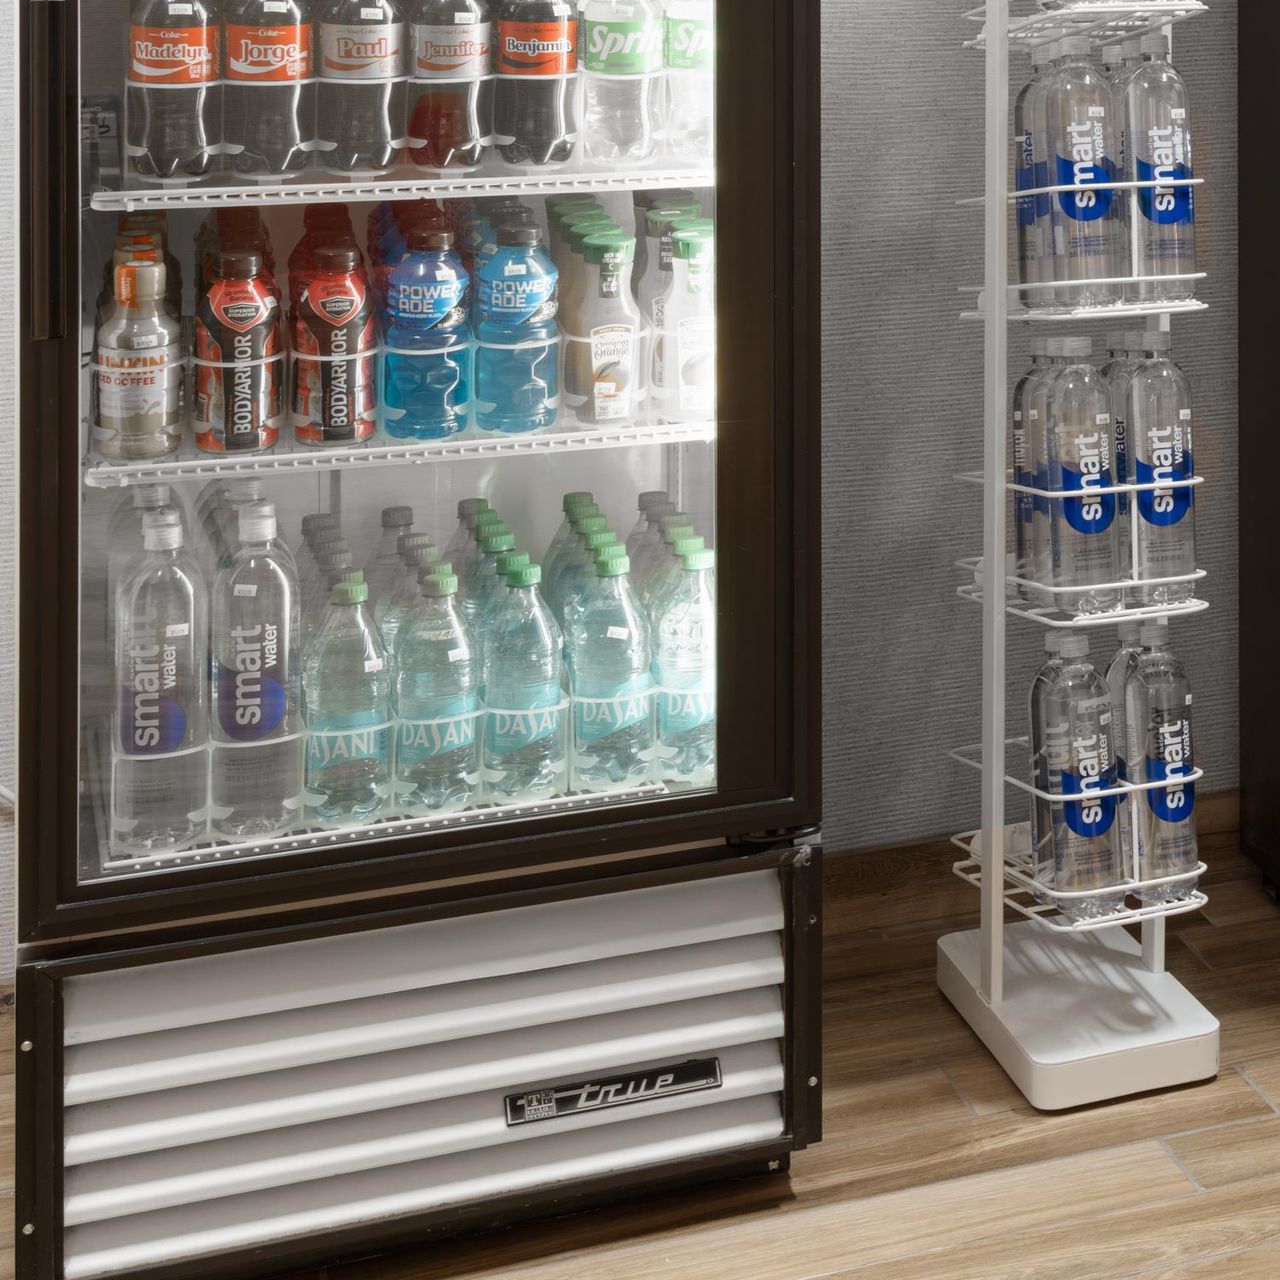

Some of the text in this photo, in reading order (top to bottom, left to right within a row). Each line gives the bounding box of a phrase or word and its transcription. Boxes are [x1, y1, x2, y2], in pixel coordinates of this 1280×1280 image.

[136, 40, 210, 65] Madelyn
[242, 39, 298, 65] Jorge
[337, 37, 388, 59] Paul
[423, 40, 486, 59] Jennifer
[506, 37, 573, 56] Benjamin
[1067, 121, 1096, 208] smart
[1148, 125, 1175, 212] smart
[399, 283, 460, 298] POWER
[233, 334, 251, 435] BODYARMOR
[330, 328, 347, 427] BODYARMOR
[1074, 432, 1102, 521] smart
[1147, 425, 1174, 513] smart
[162, 643, 177, 691] water
[229, 624, 262, 727] smart
[263, 622, 279, 668] water
[129, 638, 161, 750] smart
[1073, 734, 1103, 824] smart
[1159, 721, 1185, 809] smart
